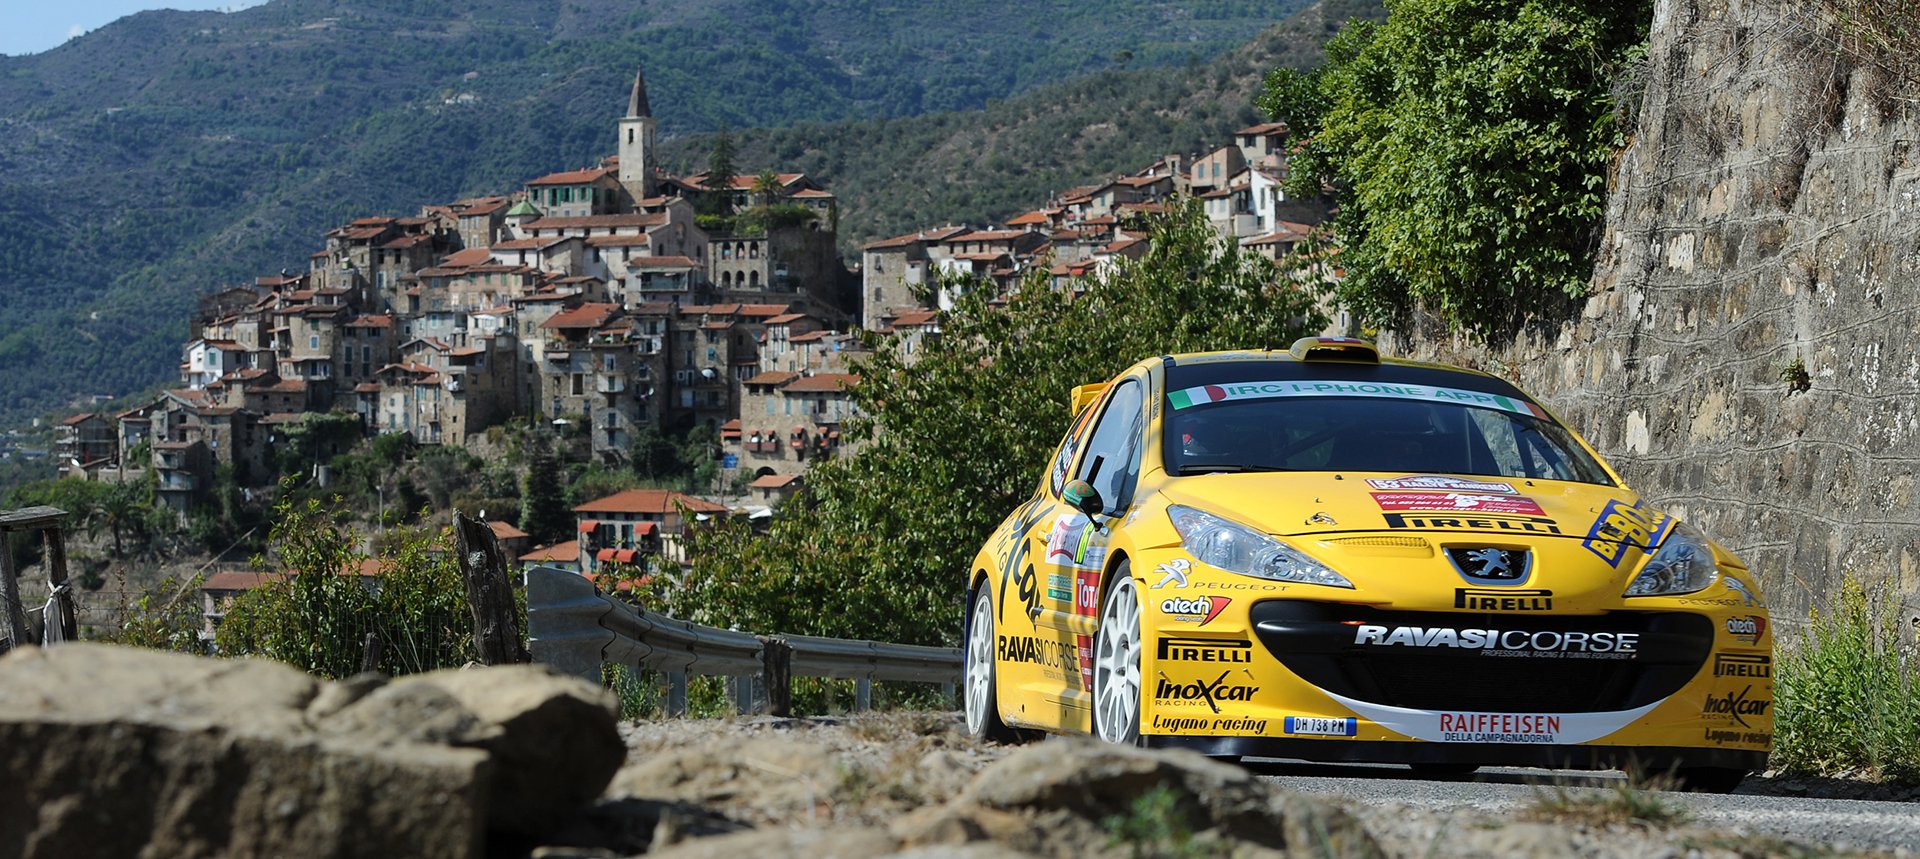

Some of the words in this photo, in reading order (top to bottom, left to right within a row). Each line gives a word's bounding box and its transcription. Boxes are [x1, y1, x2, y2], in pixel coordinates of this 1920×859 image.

[1228, 384, 1282, 396] IRC
[1292, 383, 1425, 396] I-PHONE
[1435, 391, 1492, 403] APP
[1450, 482, 1509, 491] SANREMO
[1382, 513, 1561, 534] PIRELLI
[1194, 582, 1290, 591] PEUGEOT
[1161, 595, 1210, 615] atech
[1454, 588, 1553, 610] PIRELLI
[1157, 637, 1252, 663] PIRELLI
[1481, 649, 1531, 658] PROFESSIONAL
[1713, 653, 1770, 678] PIRELLI
[1212, 716, 1267, 735] racing
[1295, 718, 1308, 731] DH
[1311, 719, 1328, 732] 738
[1331, 720, 1345, 733] PM
[1440, 713, 1560, 734] RAIFFEISEN
[1444, 732, 1473, 741] DELLA
[1475, 733, 1555, 743] CAMPAGNADORNA
